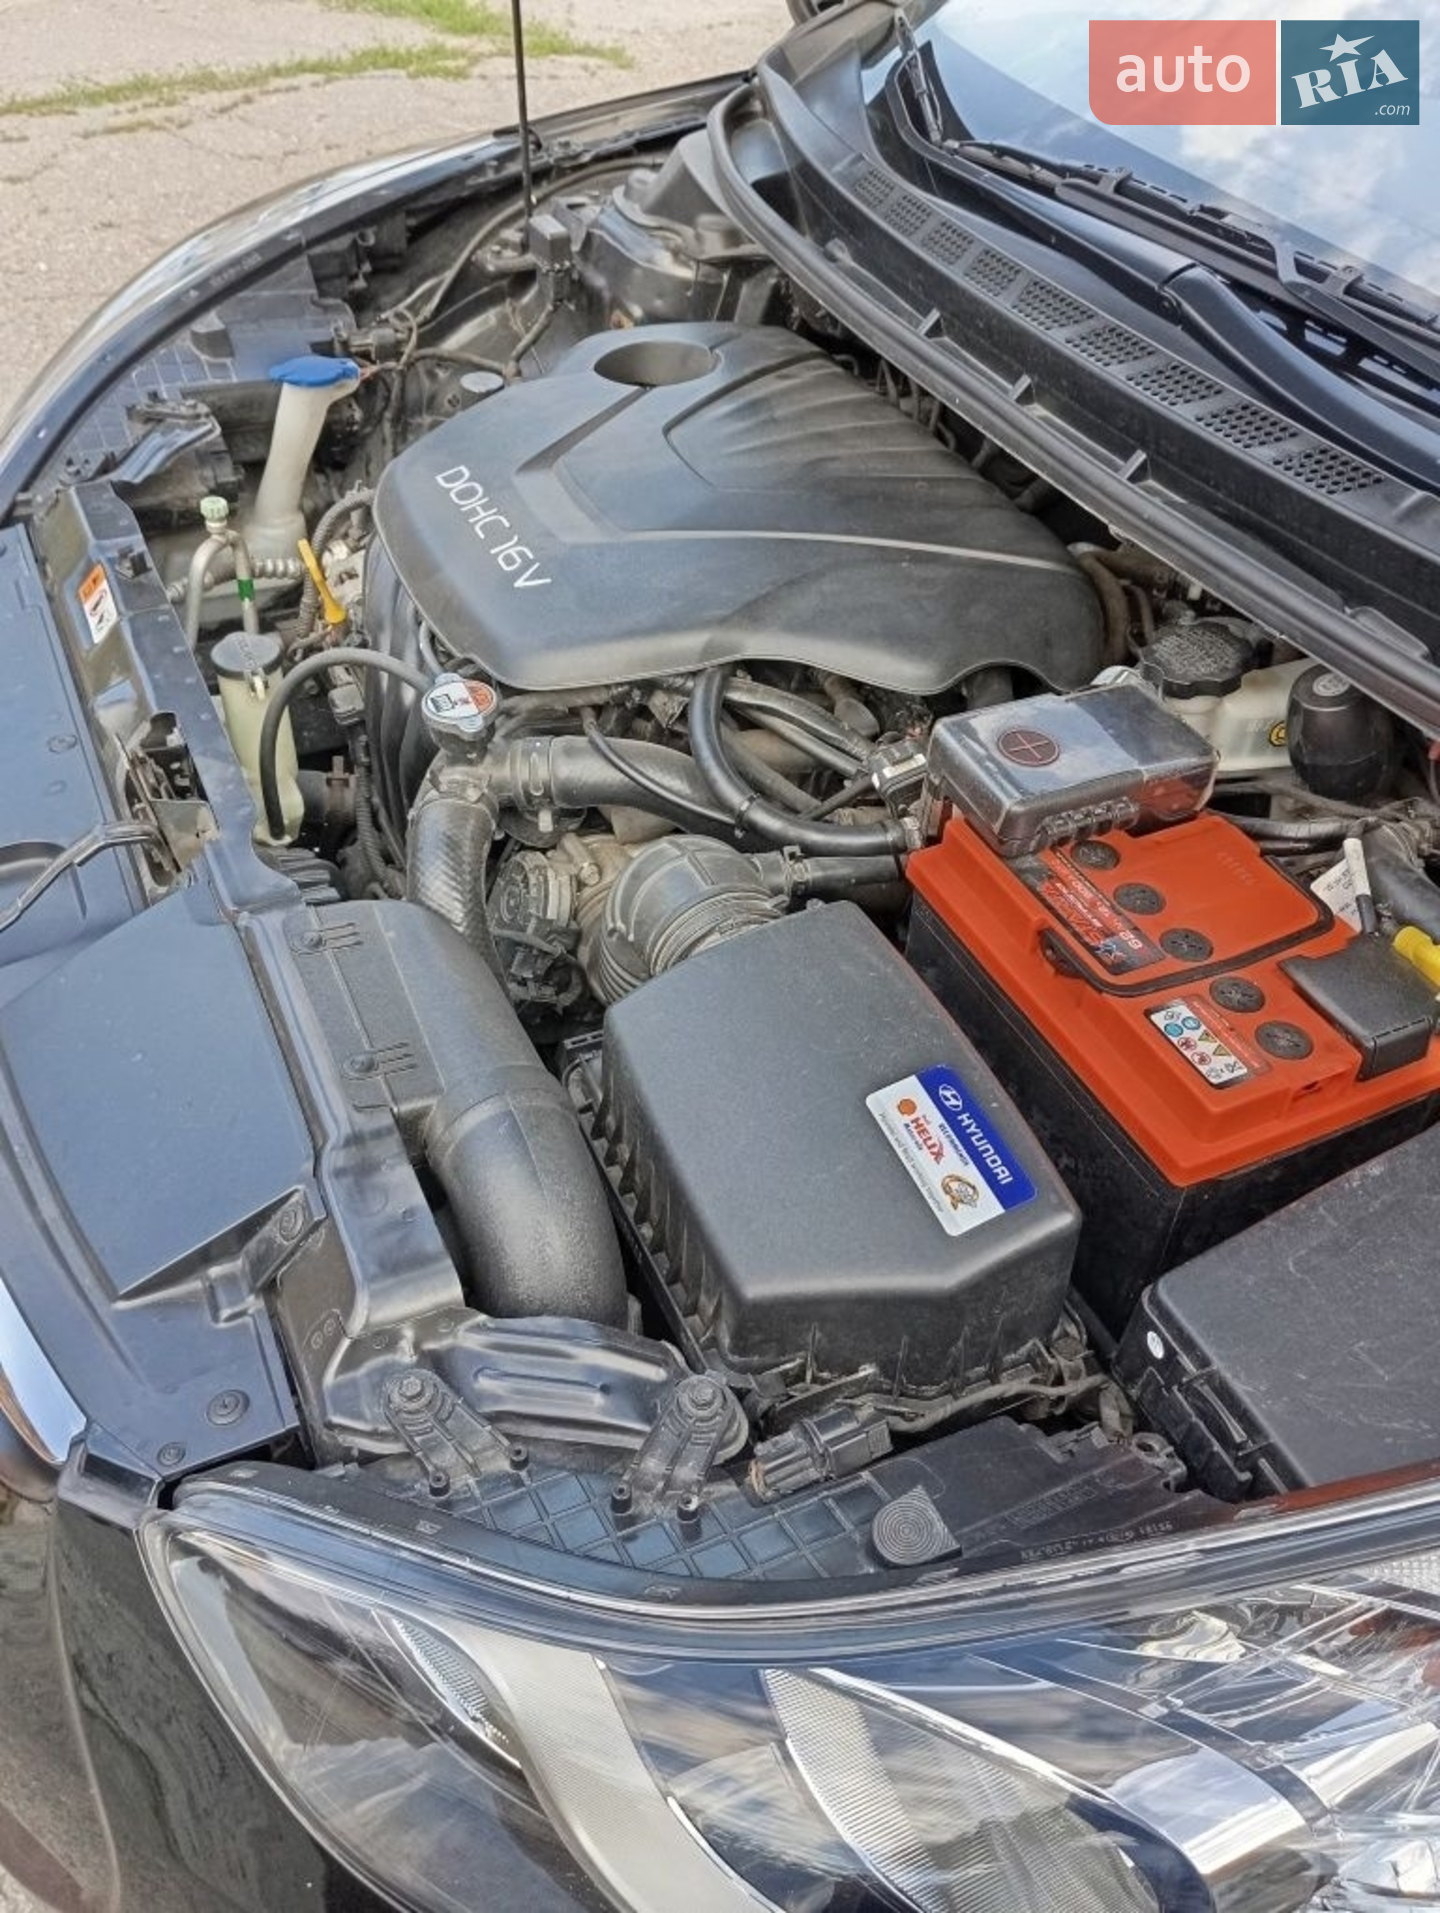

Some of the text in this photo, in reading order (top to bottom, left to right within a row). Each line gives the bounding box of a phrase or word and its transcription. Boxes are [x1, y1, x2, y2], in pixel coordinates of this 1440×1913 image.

[435, 465, 510, 539] DOHC
[911, 1117, 945, 1165] HELIX
[957, 1113, 1013, 1184] HYUNDAI
